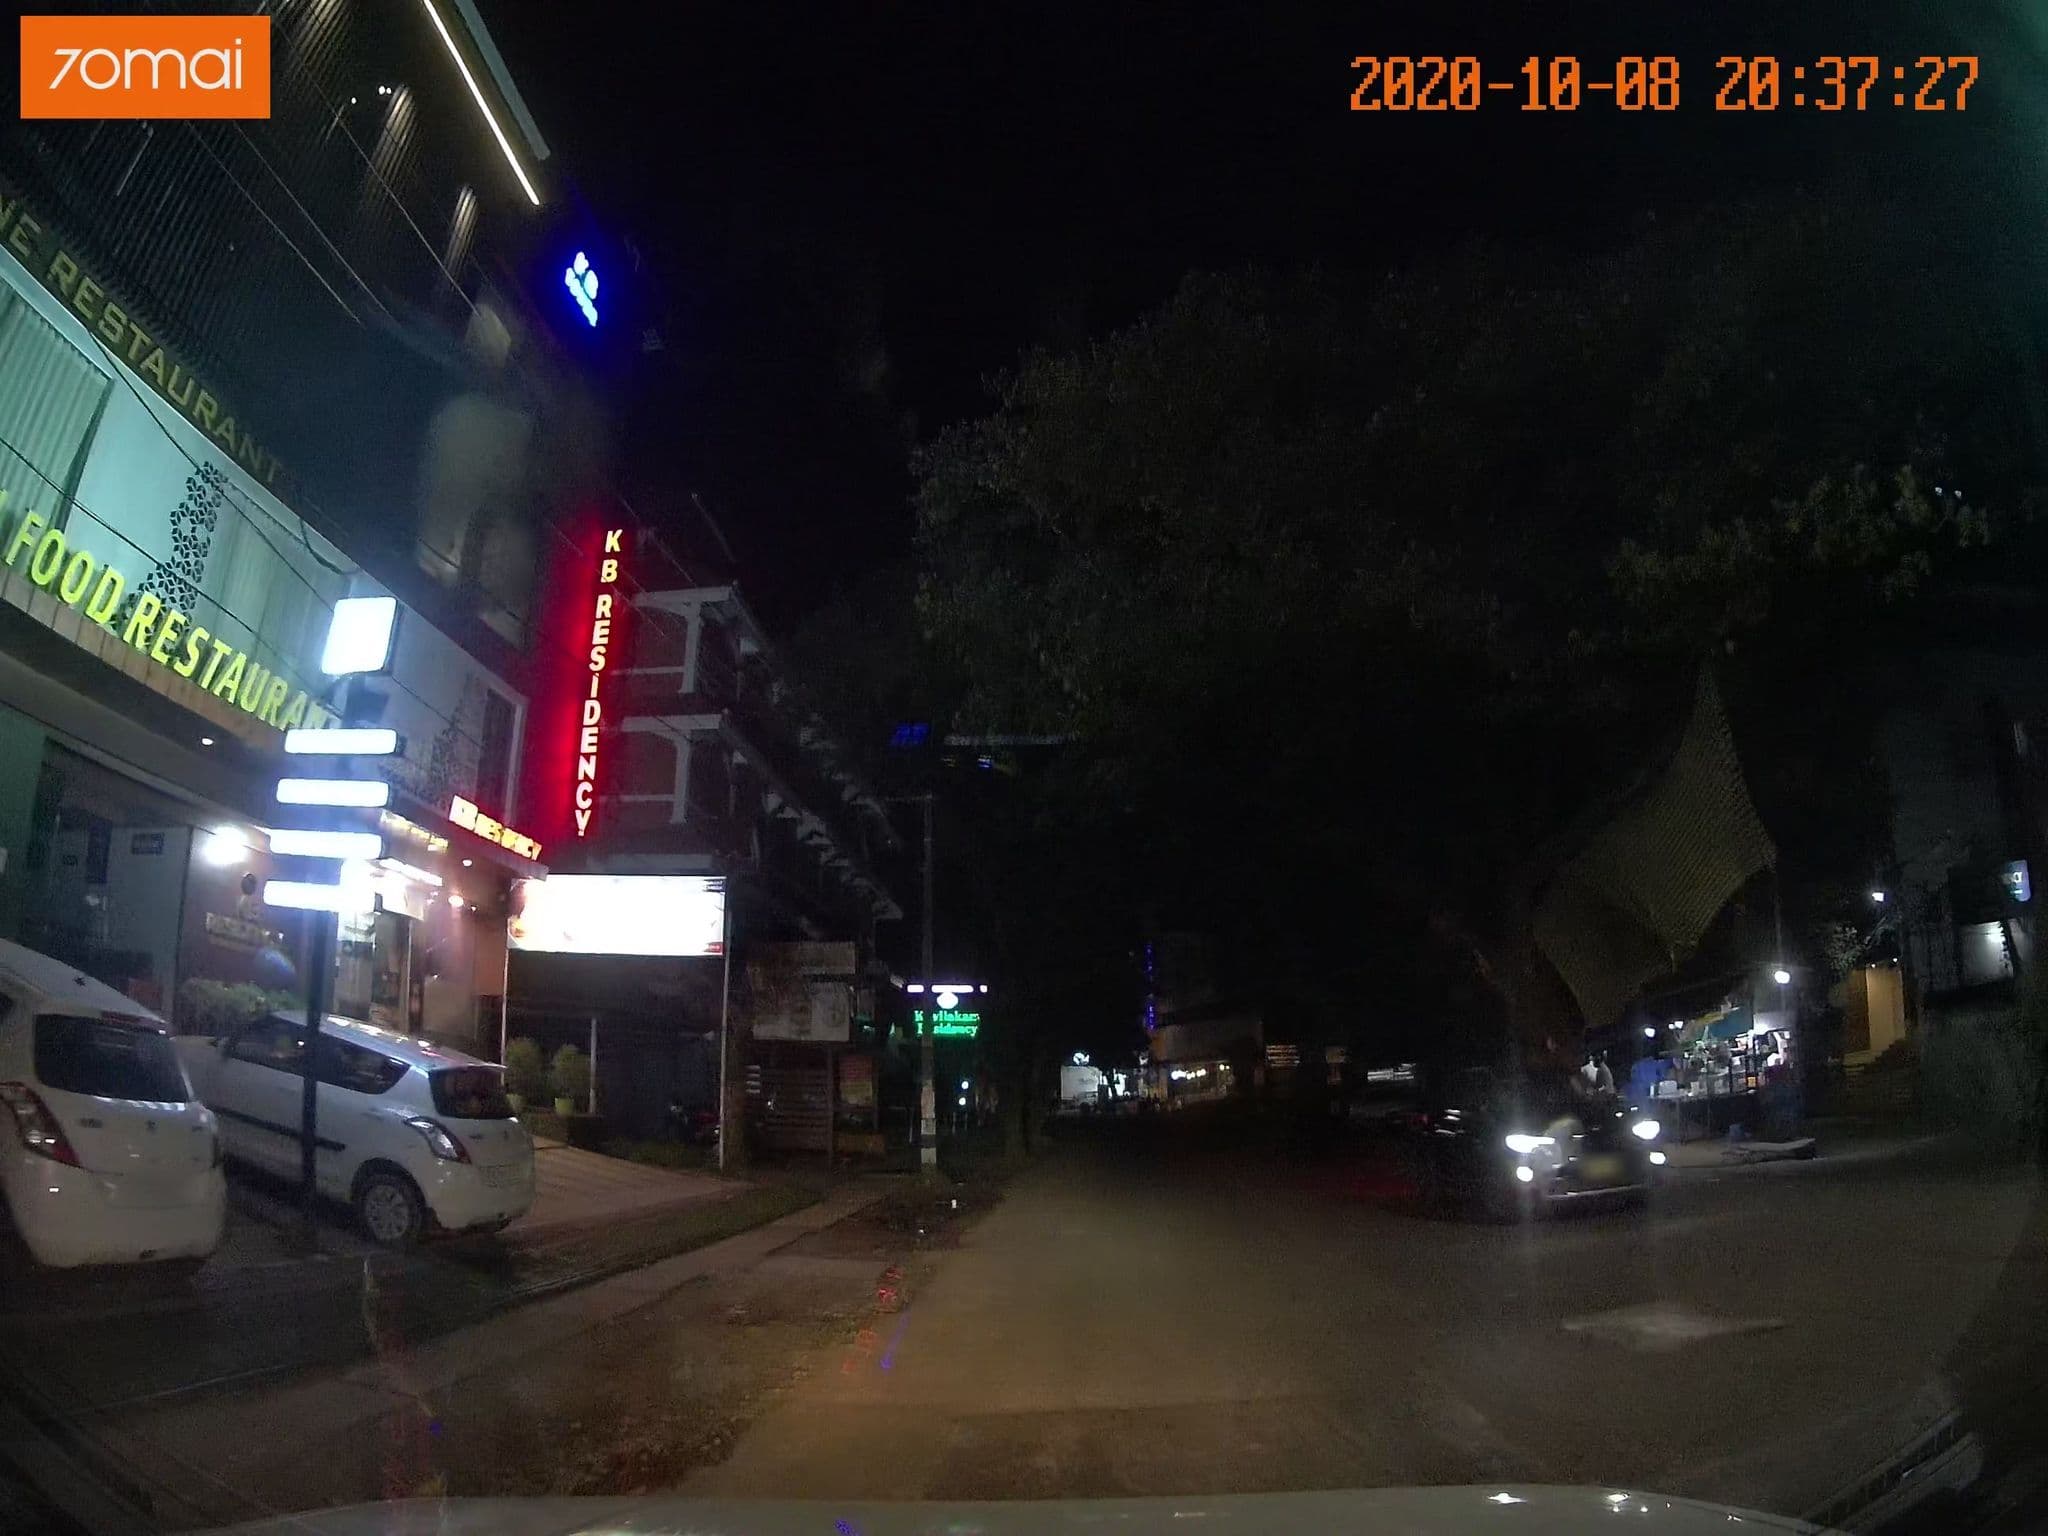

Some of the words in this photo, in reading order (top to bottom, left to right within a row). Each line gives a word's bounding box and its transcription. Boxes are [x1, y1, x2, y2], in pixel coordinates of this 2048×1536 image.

[47, 250, 281, 484] RESTAURANT
[5, 511, 125, 625] FOOD
[574, 594, 613, 837] RESIDENCY
